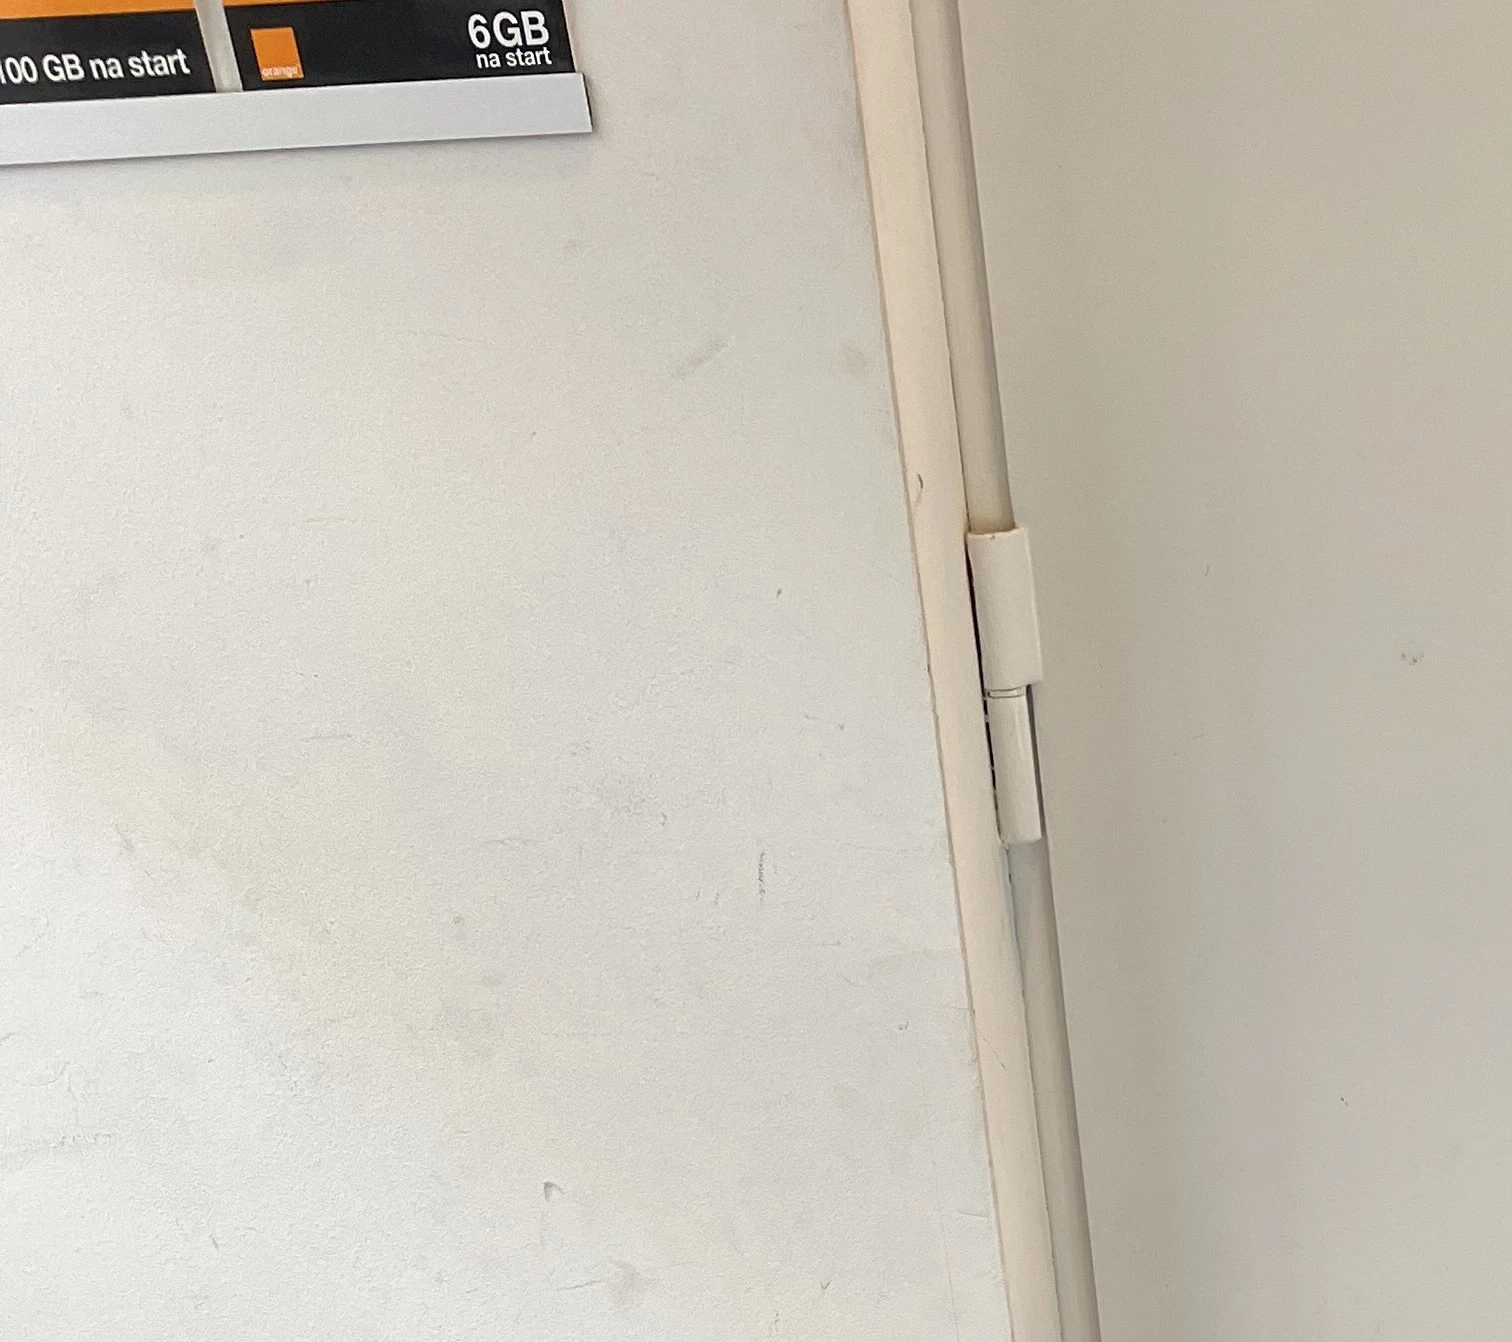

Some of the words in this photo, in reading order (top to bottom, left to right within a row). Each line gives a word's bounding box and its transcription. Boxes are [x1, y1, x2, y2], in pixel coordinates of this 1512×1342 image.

[467, 10, 550, 49] 6GB
[42, 53, 85, 82] GB
[89, 57, 125, 80] na
[128, 48, 191, 78] start
[476, 52, 500, 69] na
[506, 48, 552, 67] start
